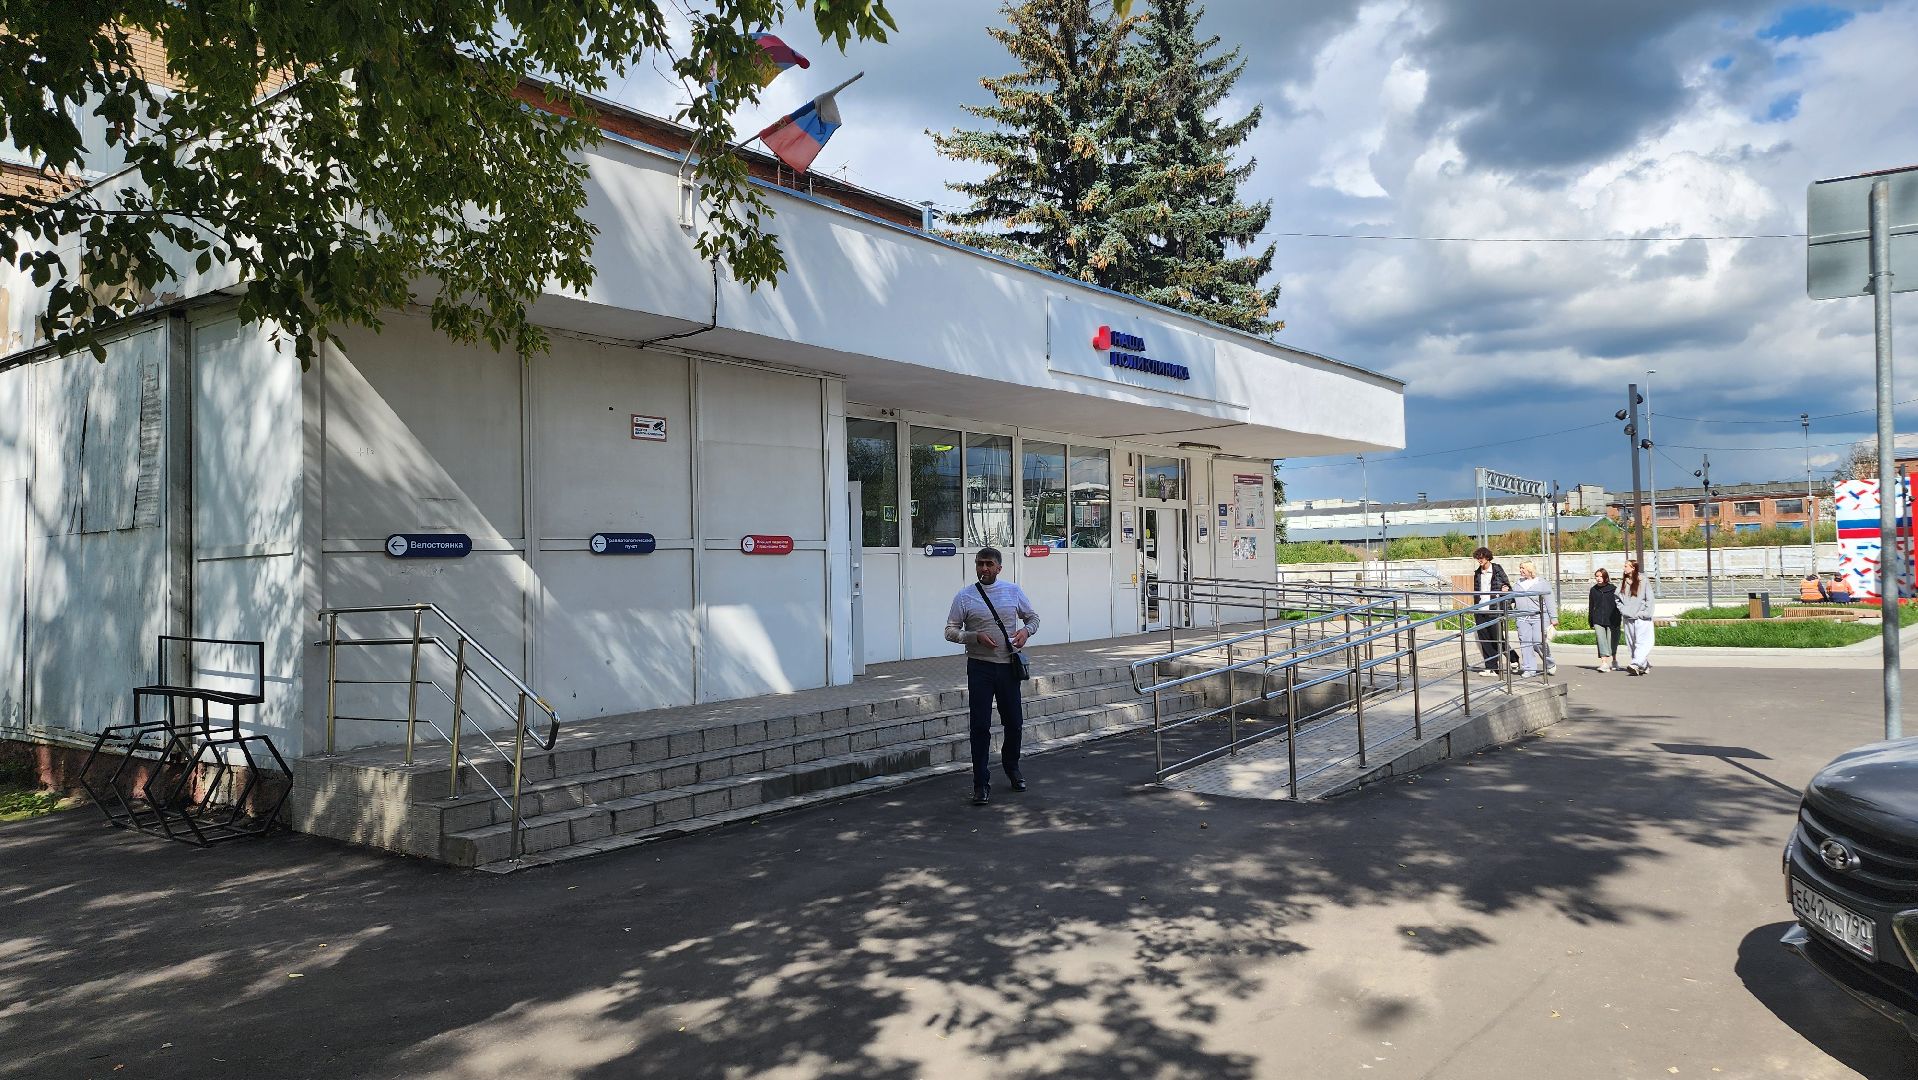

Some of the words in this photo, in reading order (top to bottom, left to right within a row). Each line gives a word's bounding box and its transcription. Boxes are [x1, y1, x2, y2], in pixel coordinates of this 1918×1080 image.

[1110, 331, 1145, 351] НАША
[1110, 352, 1190, 380] ПОЛИКЛИНИКА
[410, 540, 464, 549] Велостоянка
